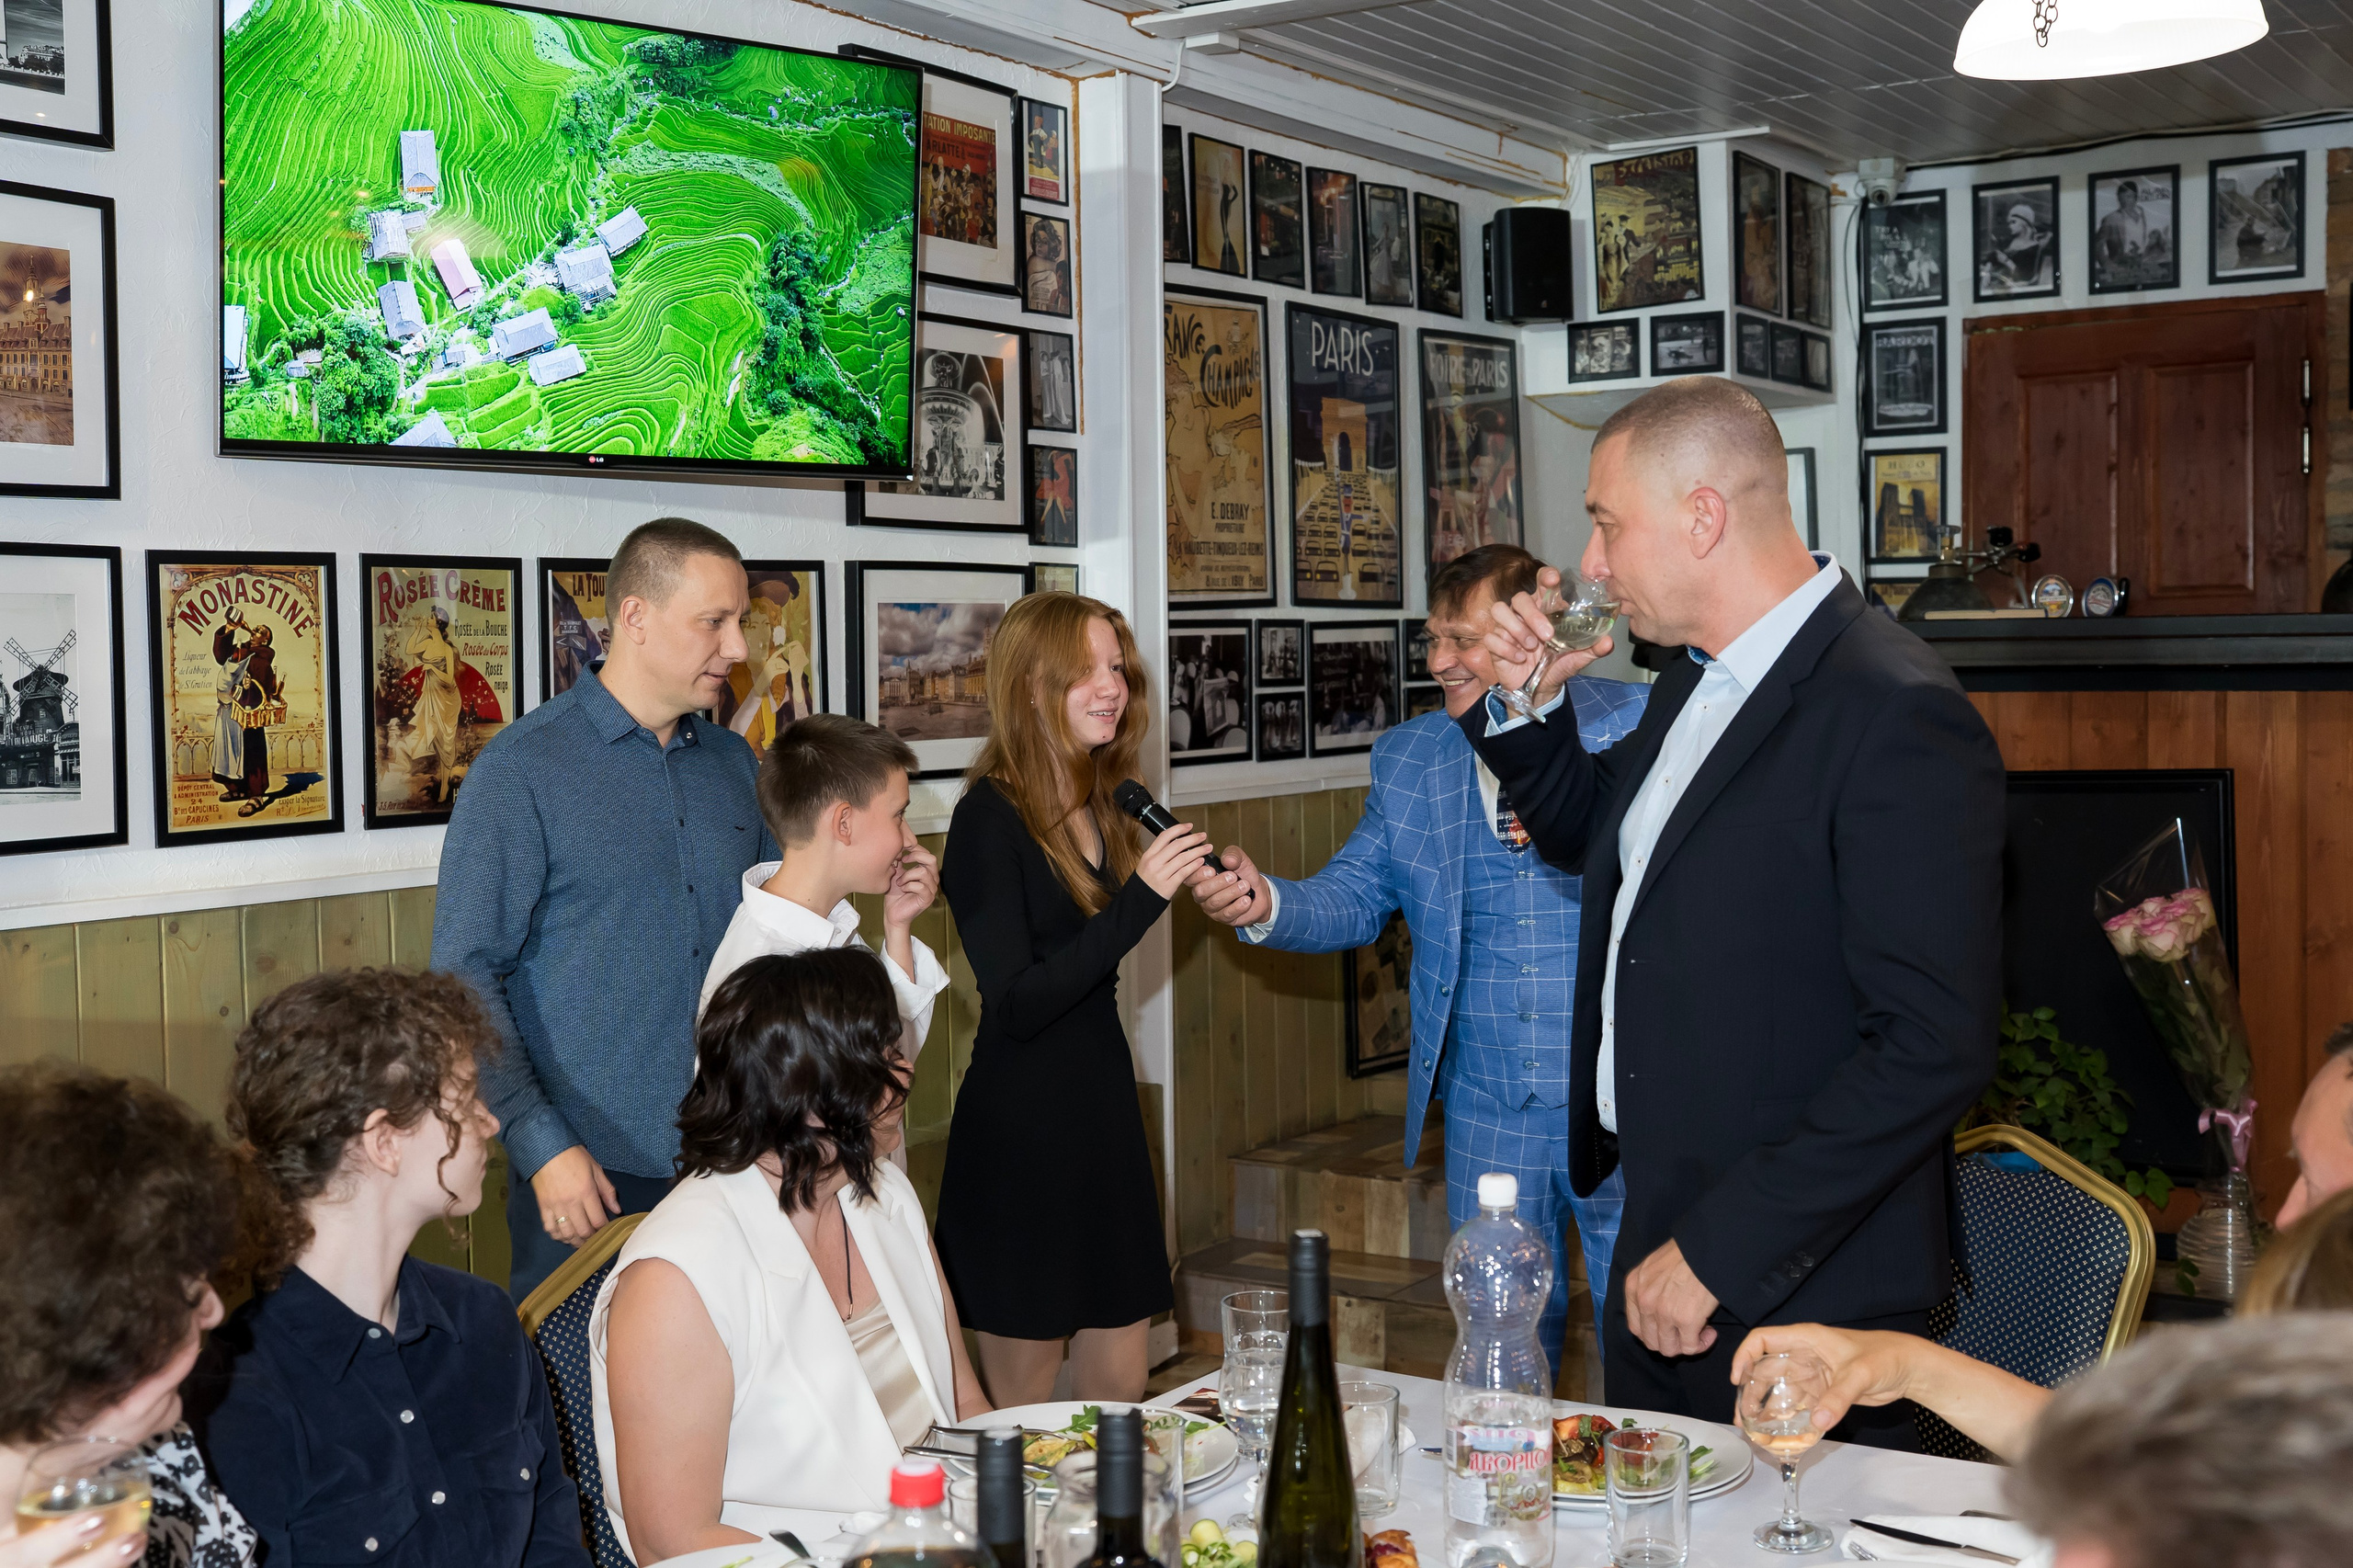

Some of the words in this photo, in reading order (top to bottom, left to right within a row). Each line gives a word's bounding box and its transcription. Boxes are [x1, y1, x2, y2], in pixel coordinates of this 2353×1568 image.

[954, 121, 995, 145] IMPOSANTE
[1312, 321, 1374, 377] PARIS
[1472, 358, 1508, 388] PARIS
[1220, 503, 1249, 520] DEBRAY
[377, 571, 440, 626] ROSÉE
[445, 570, 506, 611] CRÊME
[573, 574, 585, 596] LA
[585, 574, 608, 602] TOU
[178, 578, 314, 638] MONASTINE
[485, 619, 507, 636] BOUCHE
[182, 651, 208, 663] Liqueur
[490, 642, 508, 658] Corps
[188, 804, 220, 814] CAPUCINES
[186, 815, 210, 824] PARIS
